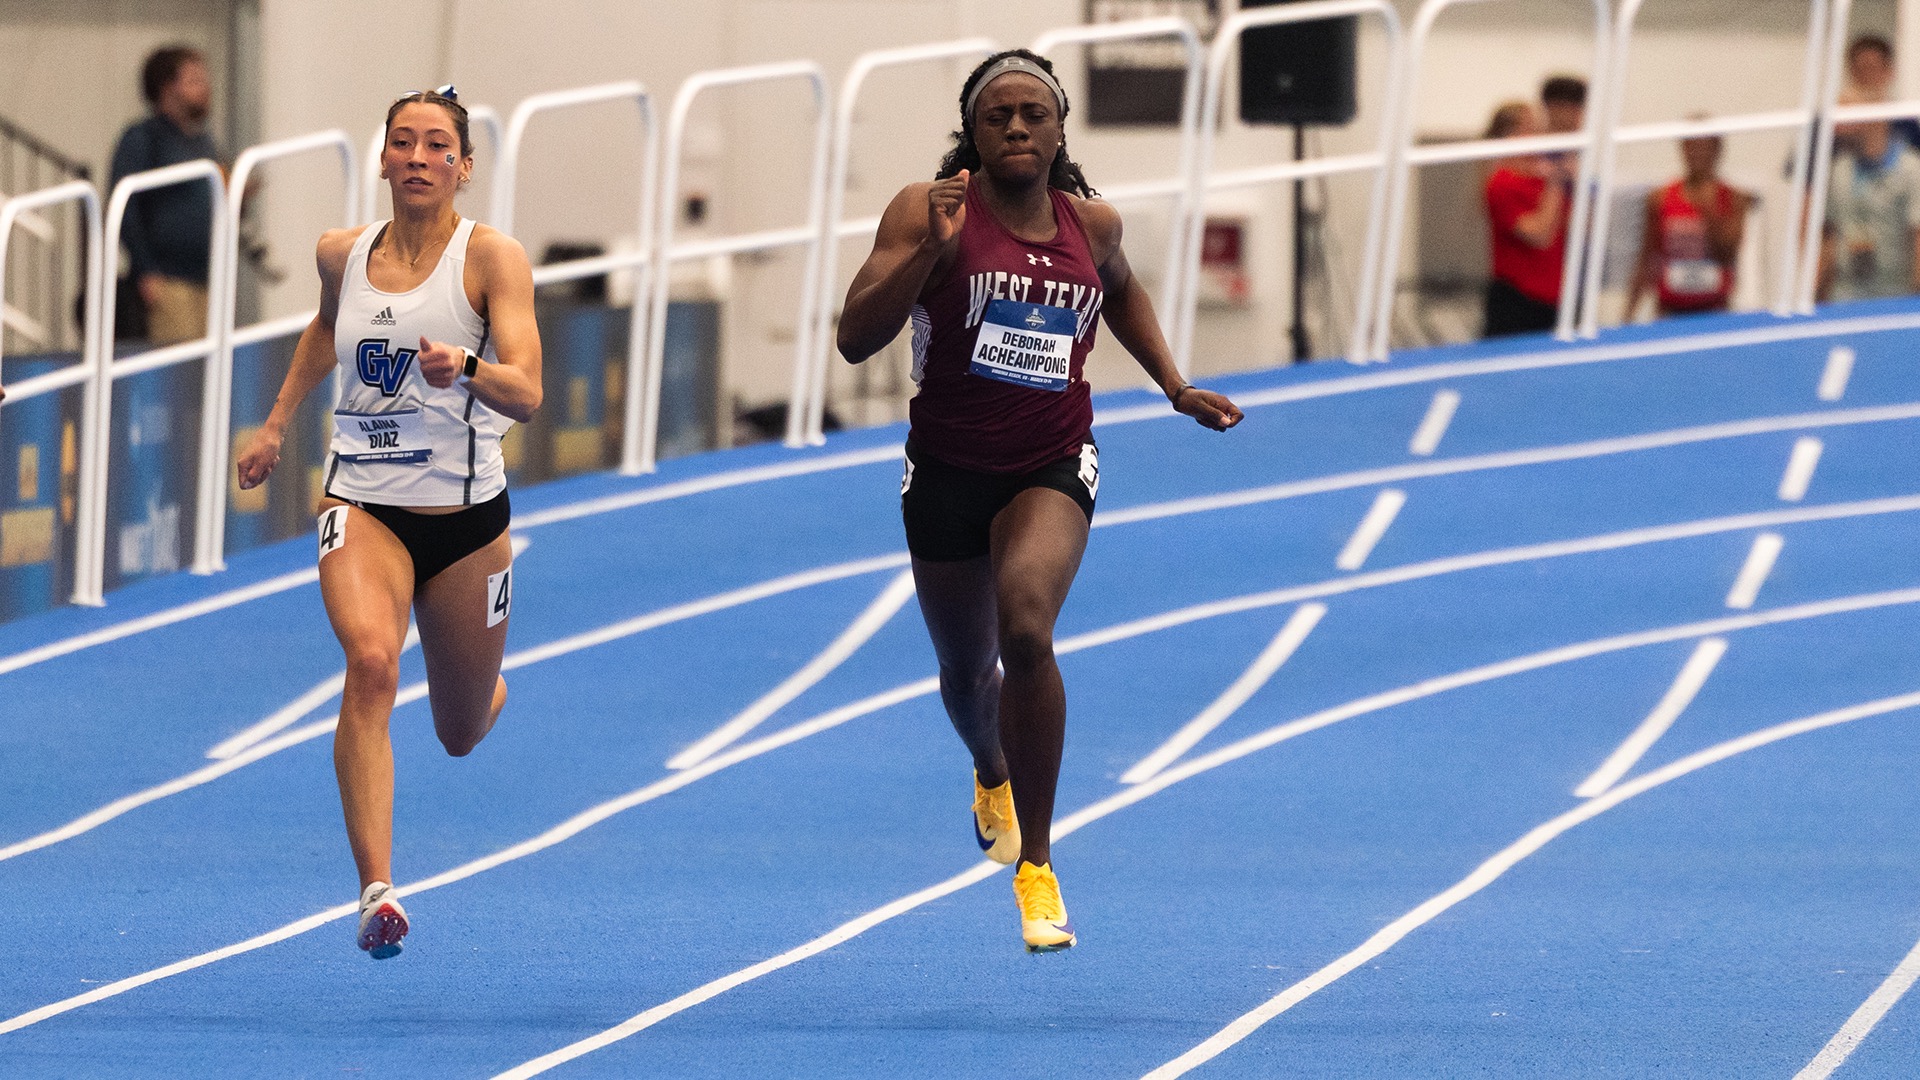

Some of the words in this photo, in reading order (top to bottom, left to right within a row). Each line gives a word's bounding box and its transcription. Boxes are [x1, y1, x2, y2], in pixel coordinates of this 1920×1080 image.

[371, 318, 397, 326] adidas
[1001, 331, 1057, 353] DEBORAH
[356, 338, 419, 397] GV
[977, 344, 1067, 374] ACHEAMPONG
[358, 419, 400, 432] ALAINA
[368, 431, 400, 449] DIAZ
[320, 509, 339, 550] 4
[494, 571, 510, 617] 4
